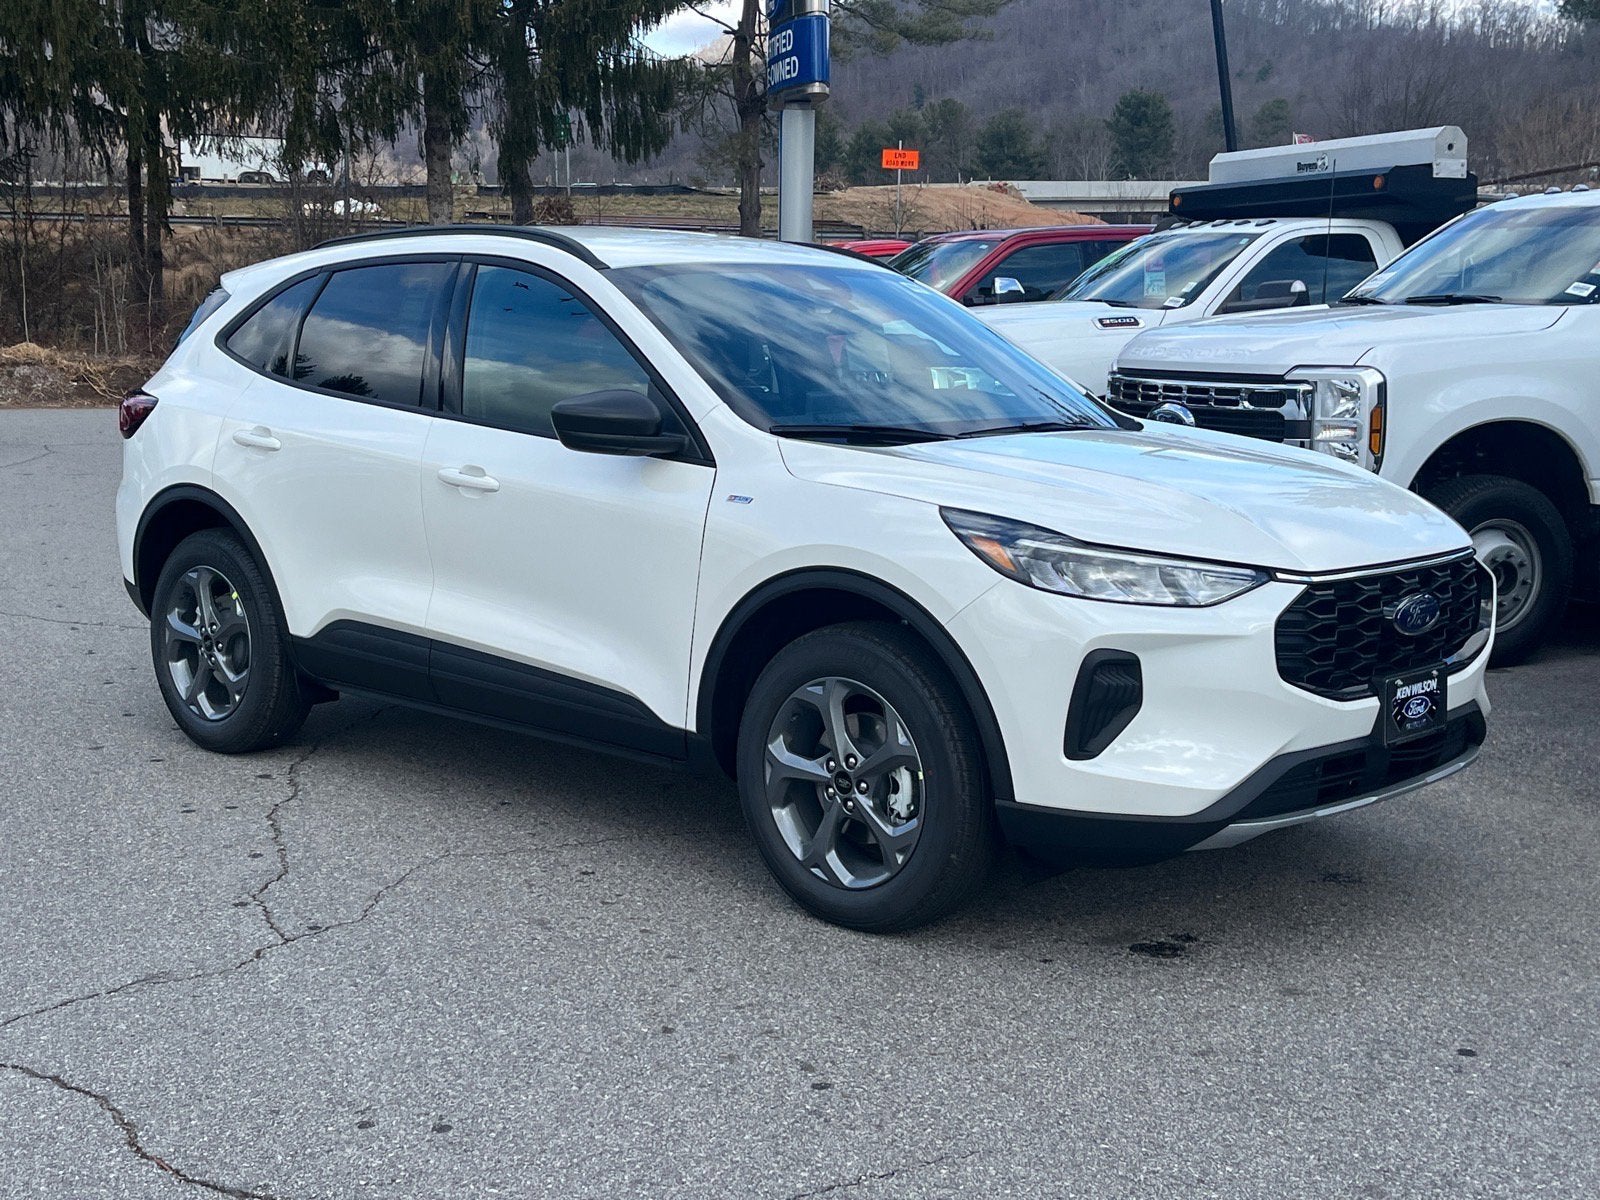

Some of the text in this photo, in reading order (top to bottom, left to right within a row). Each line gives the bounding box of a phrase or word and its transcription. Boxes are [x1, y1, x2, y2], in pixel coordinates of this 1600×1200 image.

[885, 159, 900, 167] ROAD
[1396, 678, 1437, 699] KEN WILSON
